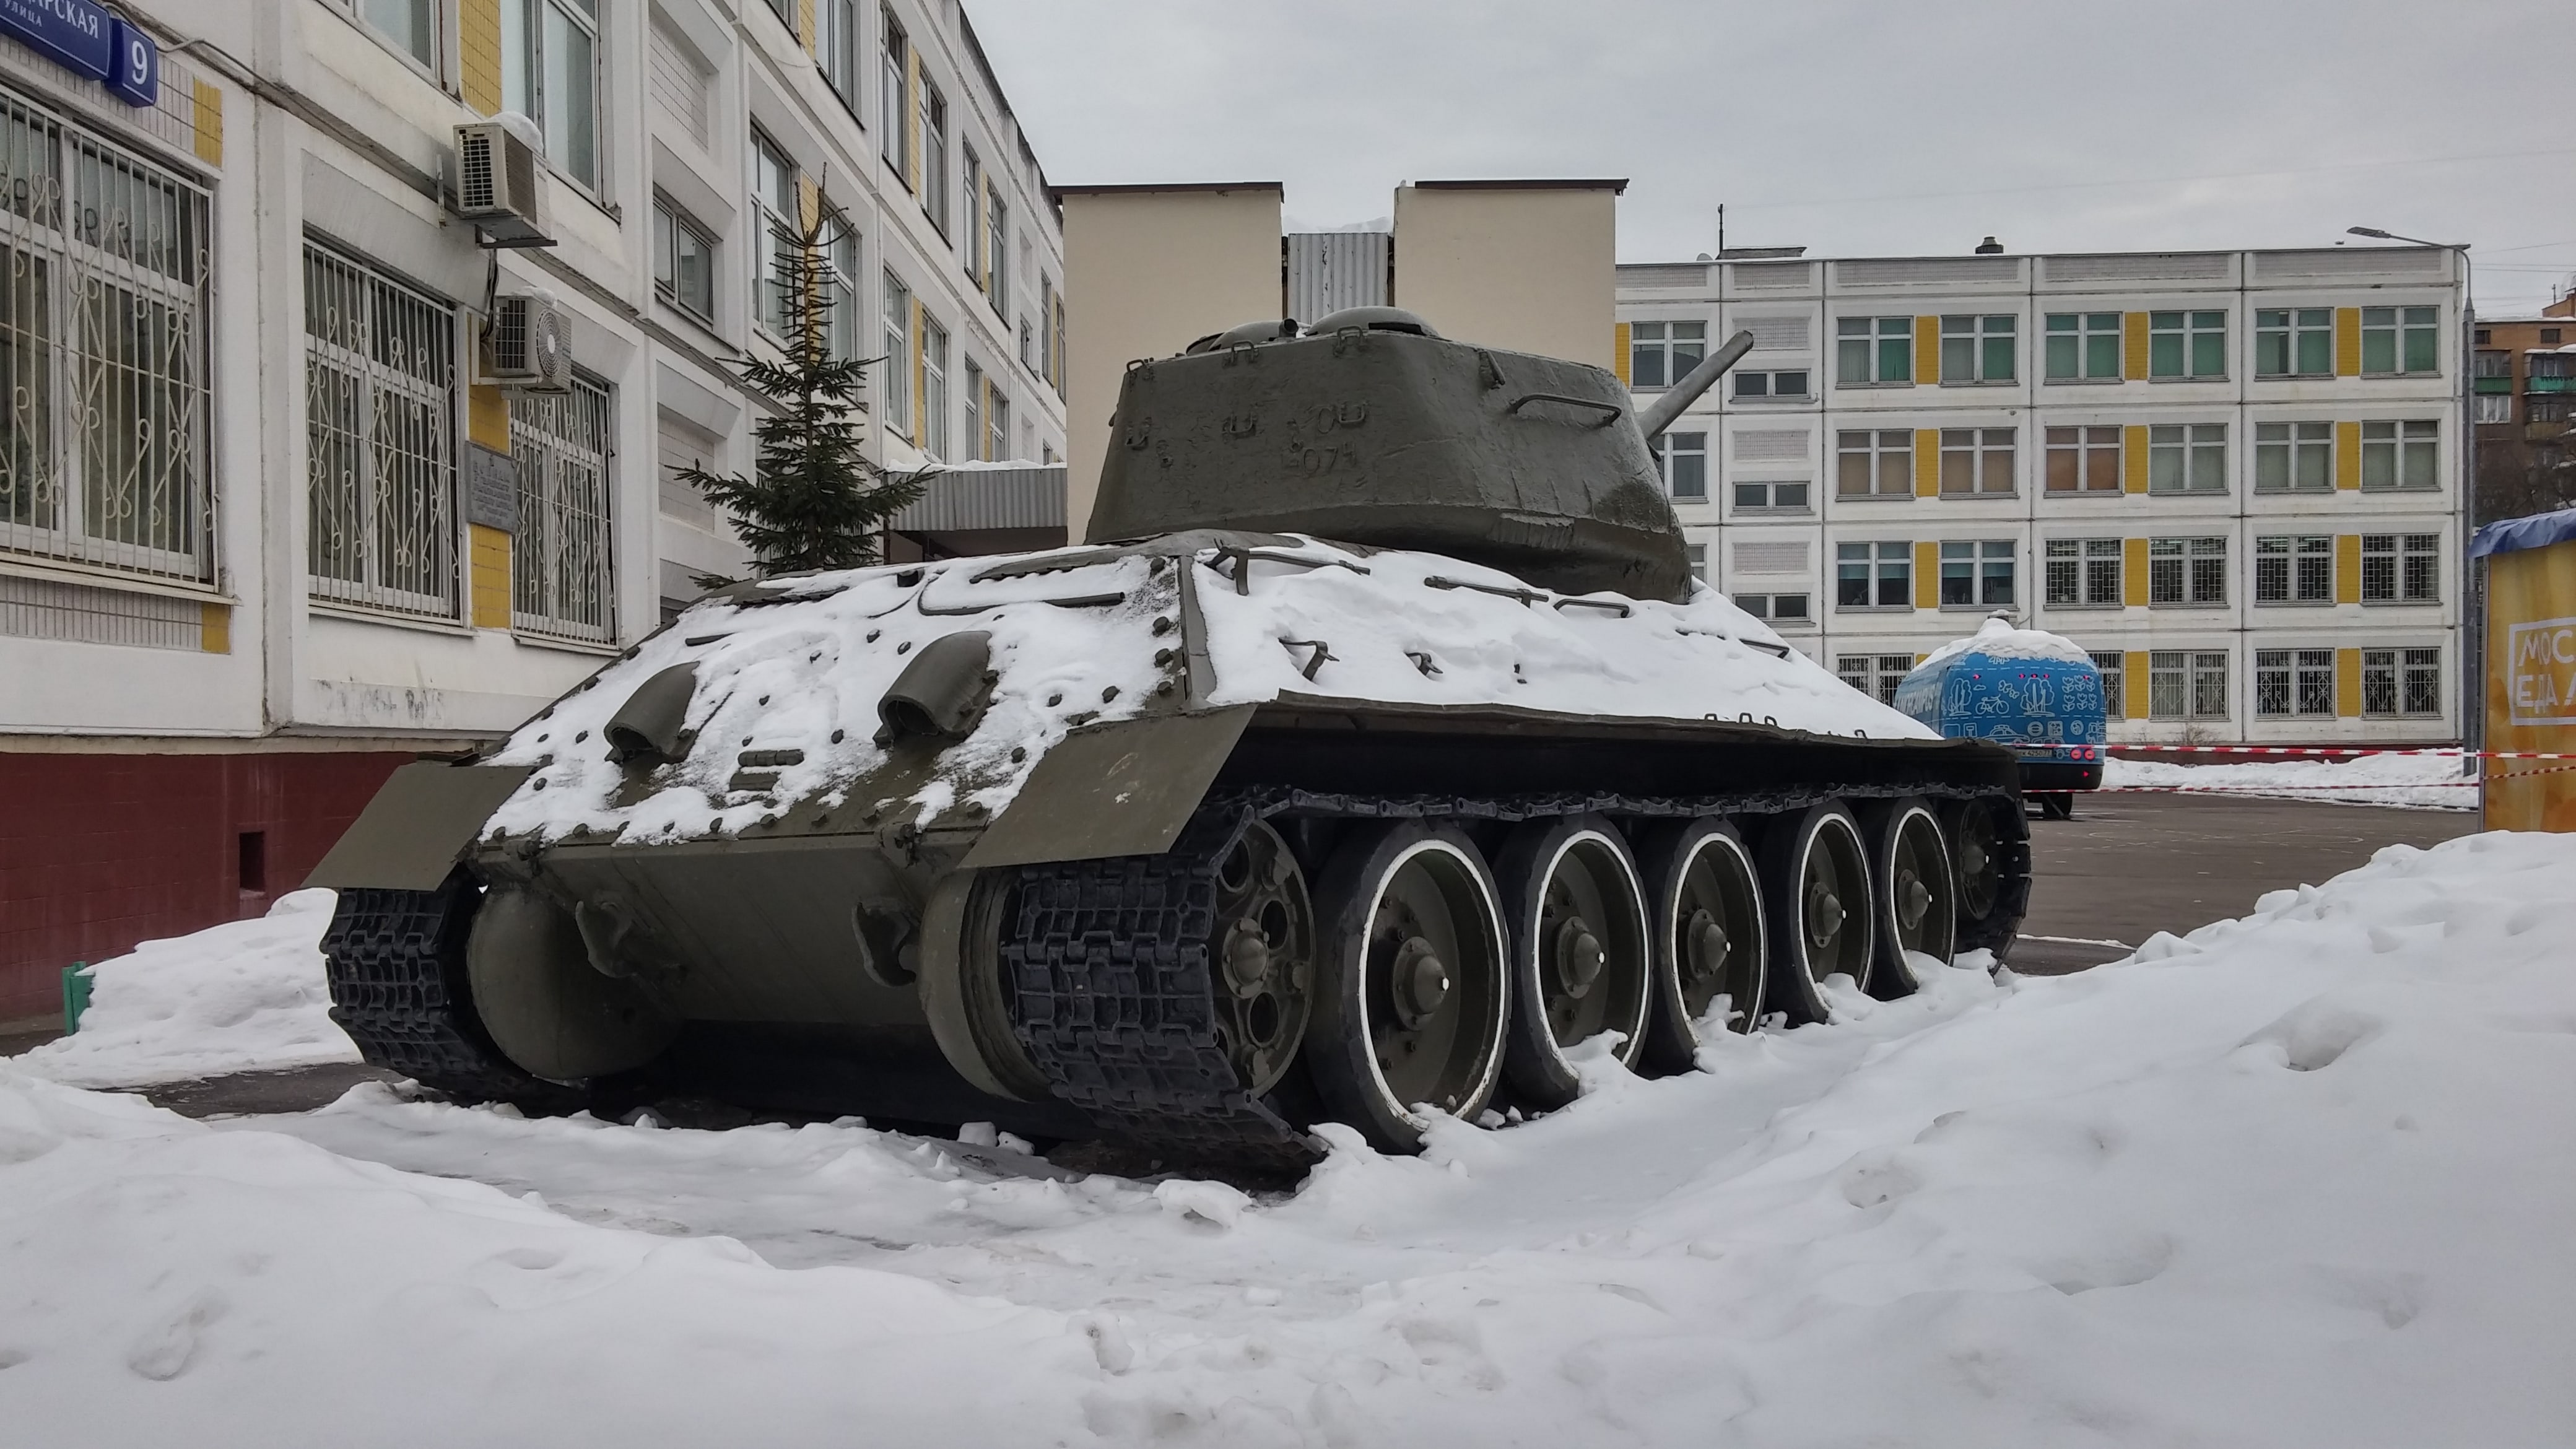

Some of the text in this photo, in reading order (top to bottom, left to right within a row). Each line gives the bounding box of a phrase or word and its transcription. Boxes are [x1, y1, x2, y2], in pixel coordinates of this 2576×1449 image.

[5, 0, 42, 27] УЛИЦА
[132, 41, 147, 84] 9
[2518, 629, 2575, 667] МОС
[2516, 674, 2559, 714] ЕДА
